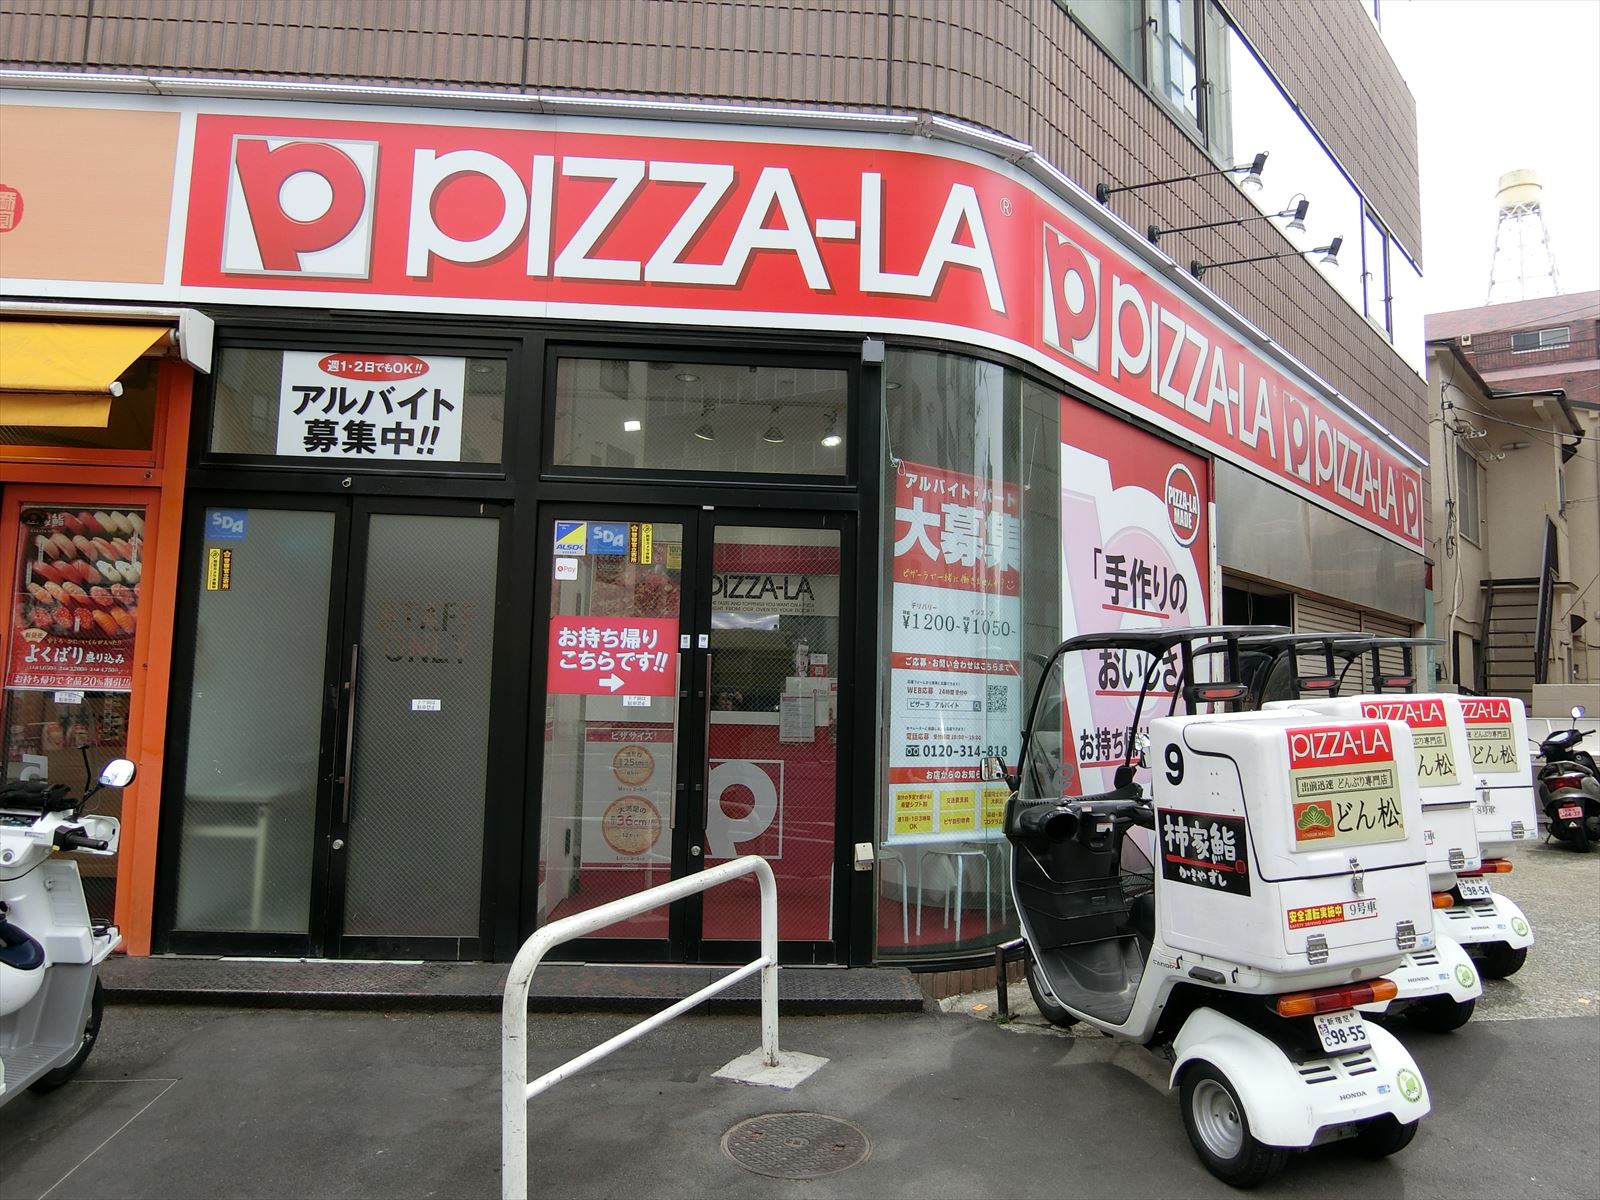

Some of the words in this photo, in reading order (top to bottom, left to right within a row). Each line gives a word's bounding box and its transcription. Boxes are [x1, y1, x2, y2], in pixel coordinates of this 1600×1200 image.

[406, 147, 1007, 314] PIZZA-LA
[1111, 274, 1277, 460] PIZZA-LA
[291, 385, 455, 421] アルバイト
[302, 418, 441, 455] 募集中!!
[1314, 415, 1400, 526] PIZZA-LA
[905, 473, 1018, 508] アルバイト・パート
[1168, 485, 1198, 515] PIZZA-LA
[212, 512, 244, 533] SDA
[1173, 507, 1192, 529] MADE
[593, 526, 624, 547] SDA
[894, 496, 1020, 572] 大募集
[558, 626, 659, 649] お持ち帰り
[559, 650, 669, 673] こちらです!!
[1364, 702, 1443, 722] PIZZA-LA
[923, 745, 1008, 757] 0120-314-818
[1290, 728, 1389, 762] PIZZA-LA
[1413, 735, 1443, 746] ぶり専門店
[1164, 743, 1185, 787] 9
[1417, 752, 1454, 776] ん松
[1472, 744, 1515, 765] どん松
[926, 770, 981, 780] お店からのお知ら
[1336, 797, 1401, 833] どん松
[1288, 905, 1343, 924] 安全運転実施中
[1349, 901, 1377, 916] 9号車
[1407, 975, 1430, 983] HONDA
[1330, 1024, 1366, 1045] 98-55
[1339, 1089, 1367, 1101] HONDA
